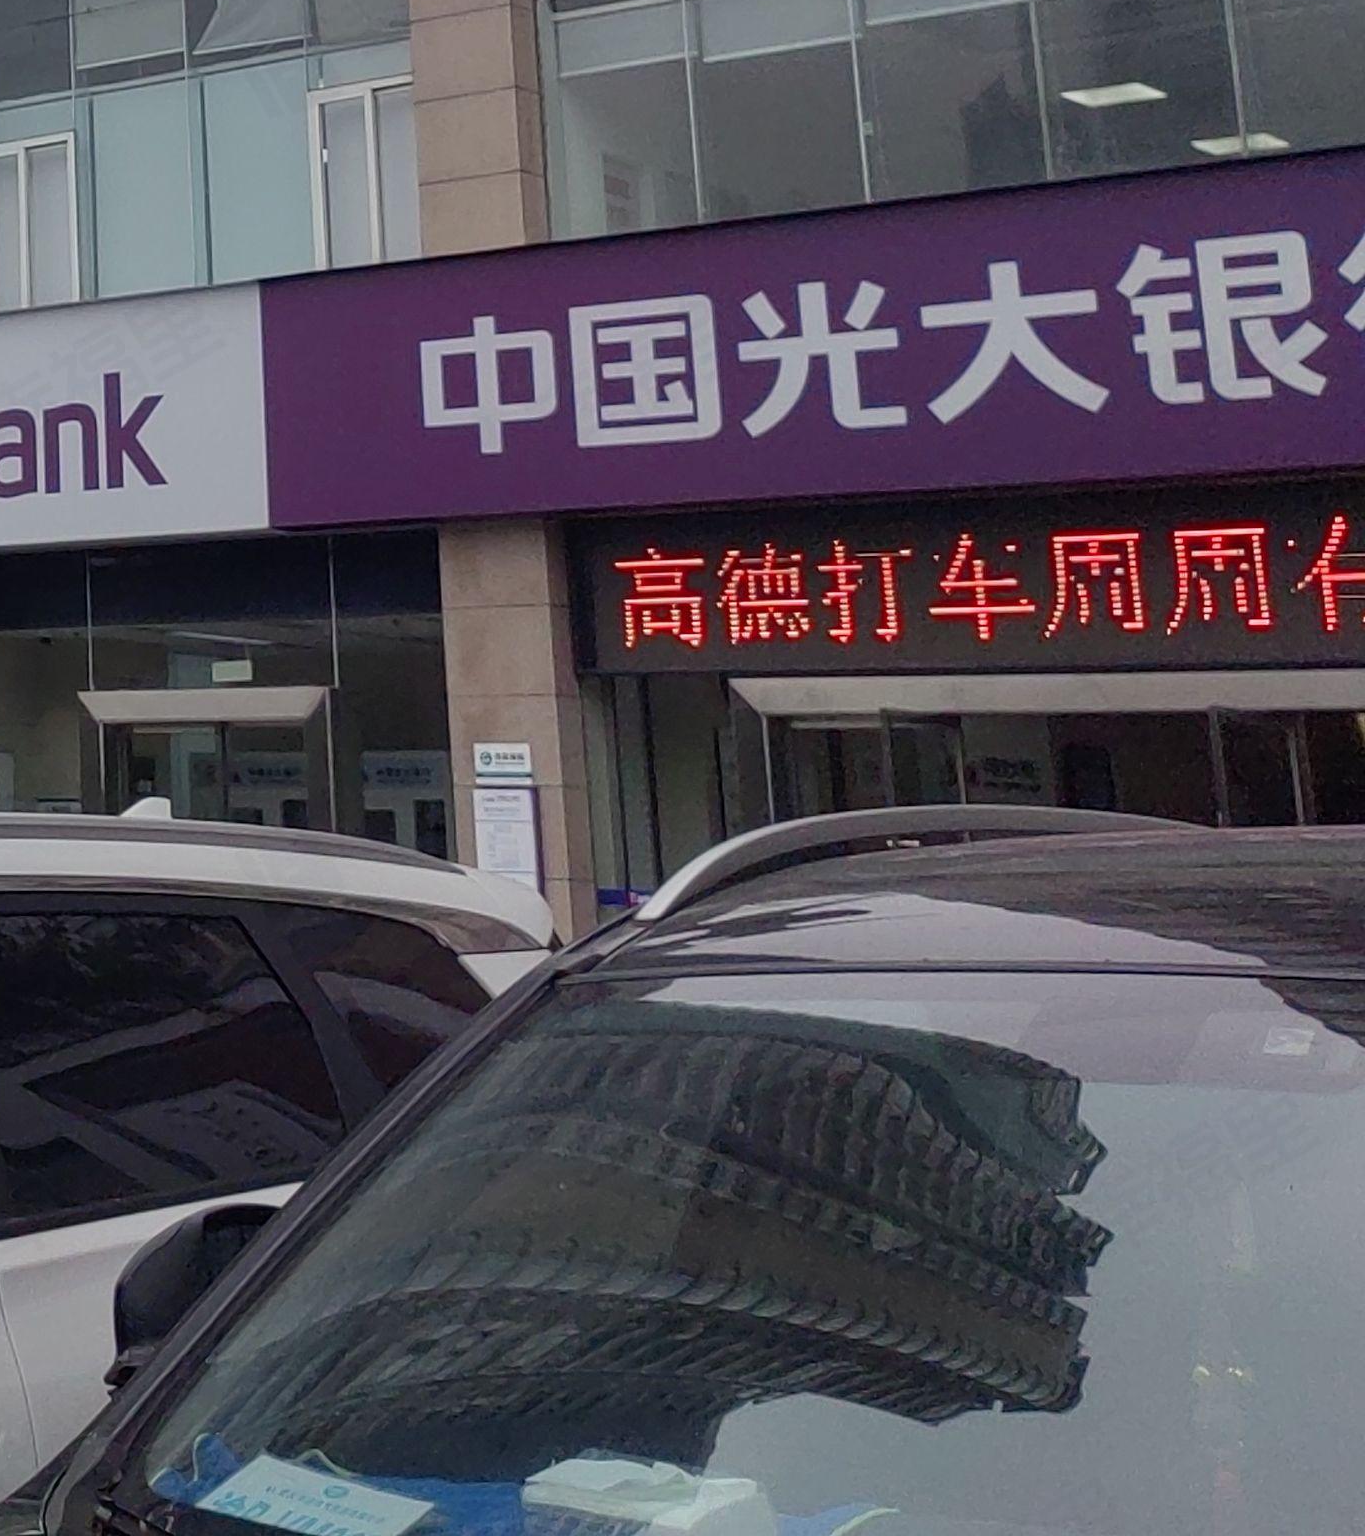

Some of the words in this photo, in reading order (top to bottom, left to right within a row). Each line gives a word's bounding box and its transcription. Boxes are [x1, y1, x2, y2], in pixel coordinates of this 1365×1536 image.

[420, 227, 1365, 455] 中国光大银
